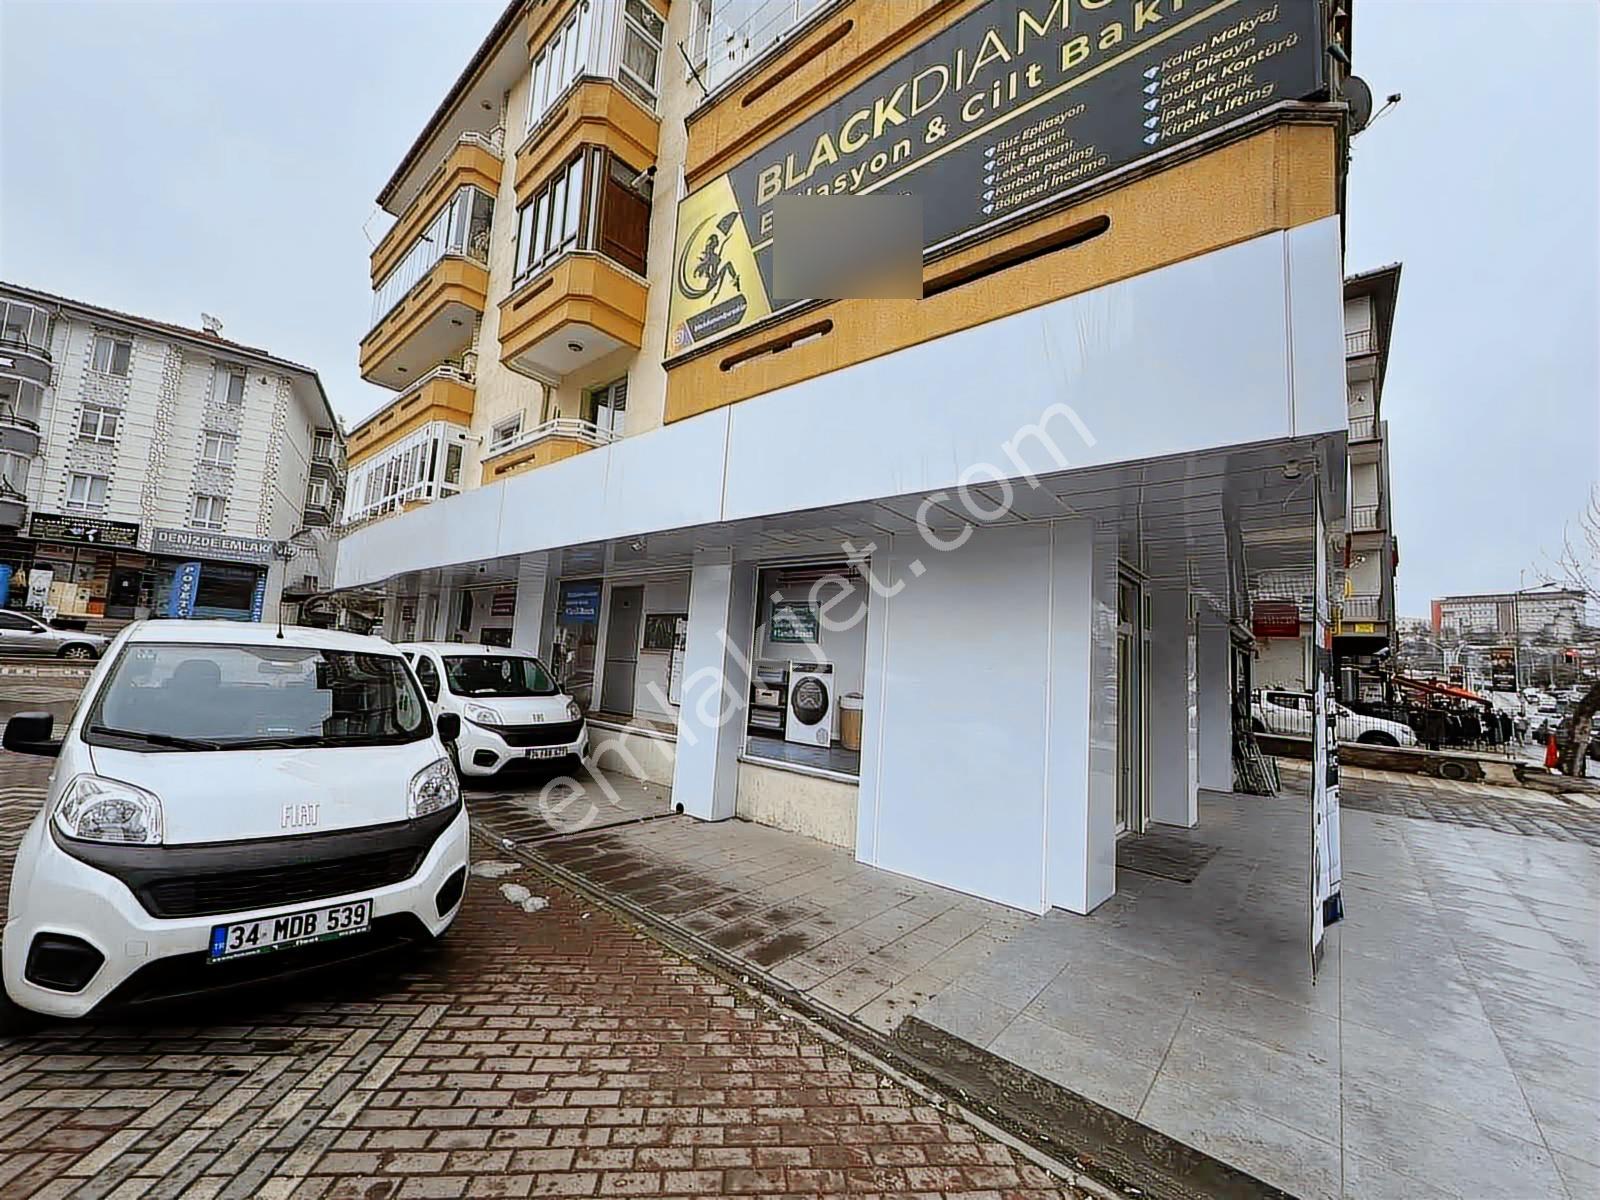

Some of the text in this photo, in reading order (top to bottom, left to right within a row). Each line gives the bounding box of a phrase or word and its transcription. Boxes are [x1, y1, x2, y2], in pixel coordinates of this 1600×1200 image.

[1161, 4, 1279, 72] Kalıcı Makyaj
[1161, 37, 1256, 89] Kaş Dizayn
[1161, 32, 1298, 106] Dudak Kontürü
[757, 0, 1112, 206] BLACKDIAM
[925, 116, 948, 144] &
[961, 63, 1042, 122] Cilt
[1022, 104, 1086, 140] Epilasyon
[1161, 74, 1254, 124] İpek Kirpik
[1161, 83, 1274, 140] Kirpik Lifting
[995, 140, 1073, 182] Leke Bakımı
[995, 146, 1094, 196] Karbon Peeling
[996, 128, 1065, 166] Cilt Bakımı
[159, 532, 220, 548] DENİZDE
[221, 539, 271, 554] EMLAK
[280, 803, 320, 828] FIAT
[230, 923, 260, 950] 34
[273, 914, 318, 942] MDB
[327, 905, 365, 931] 539
